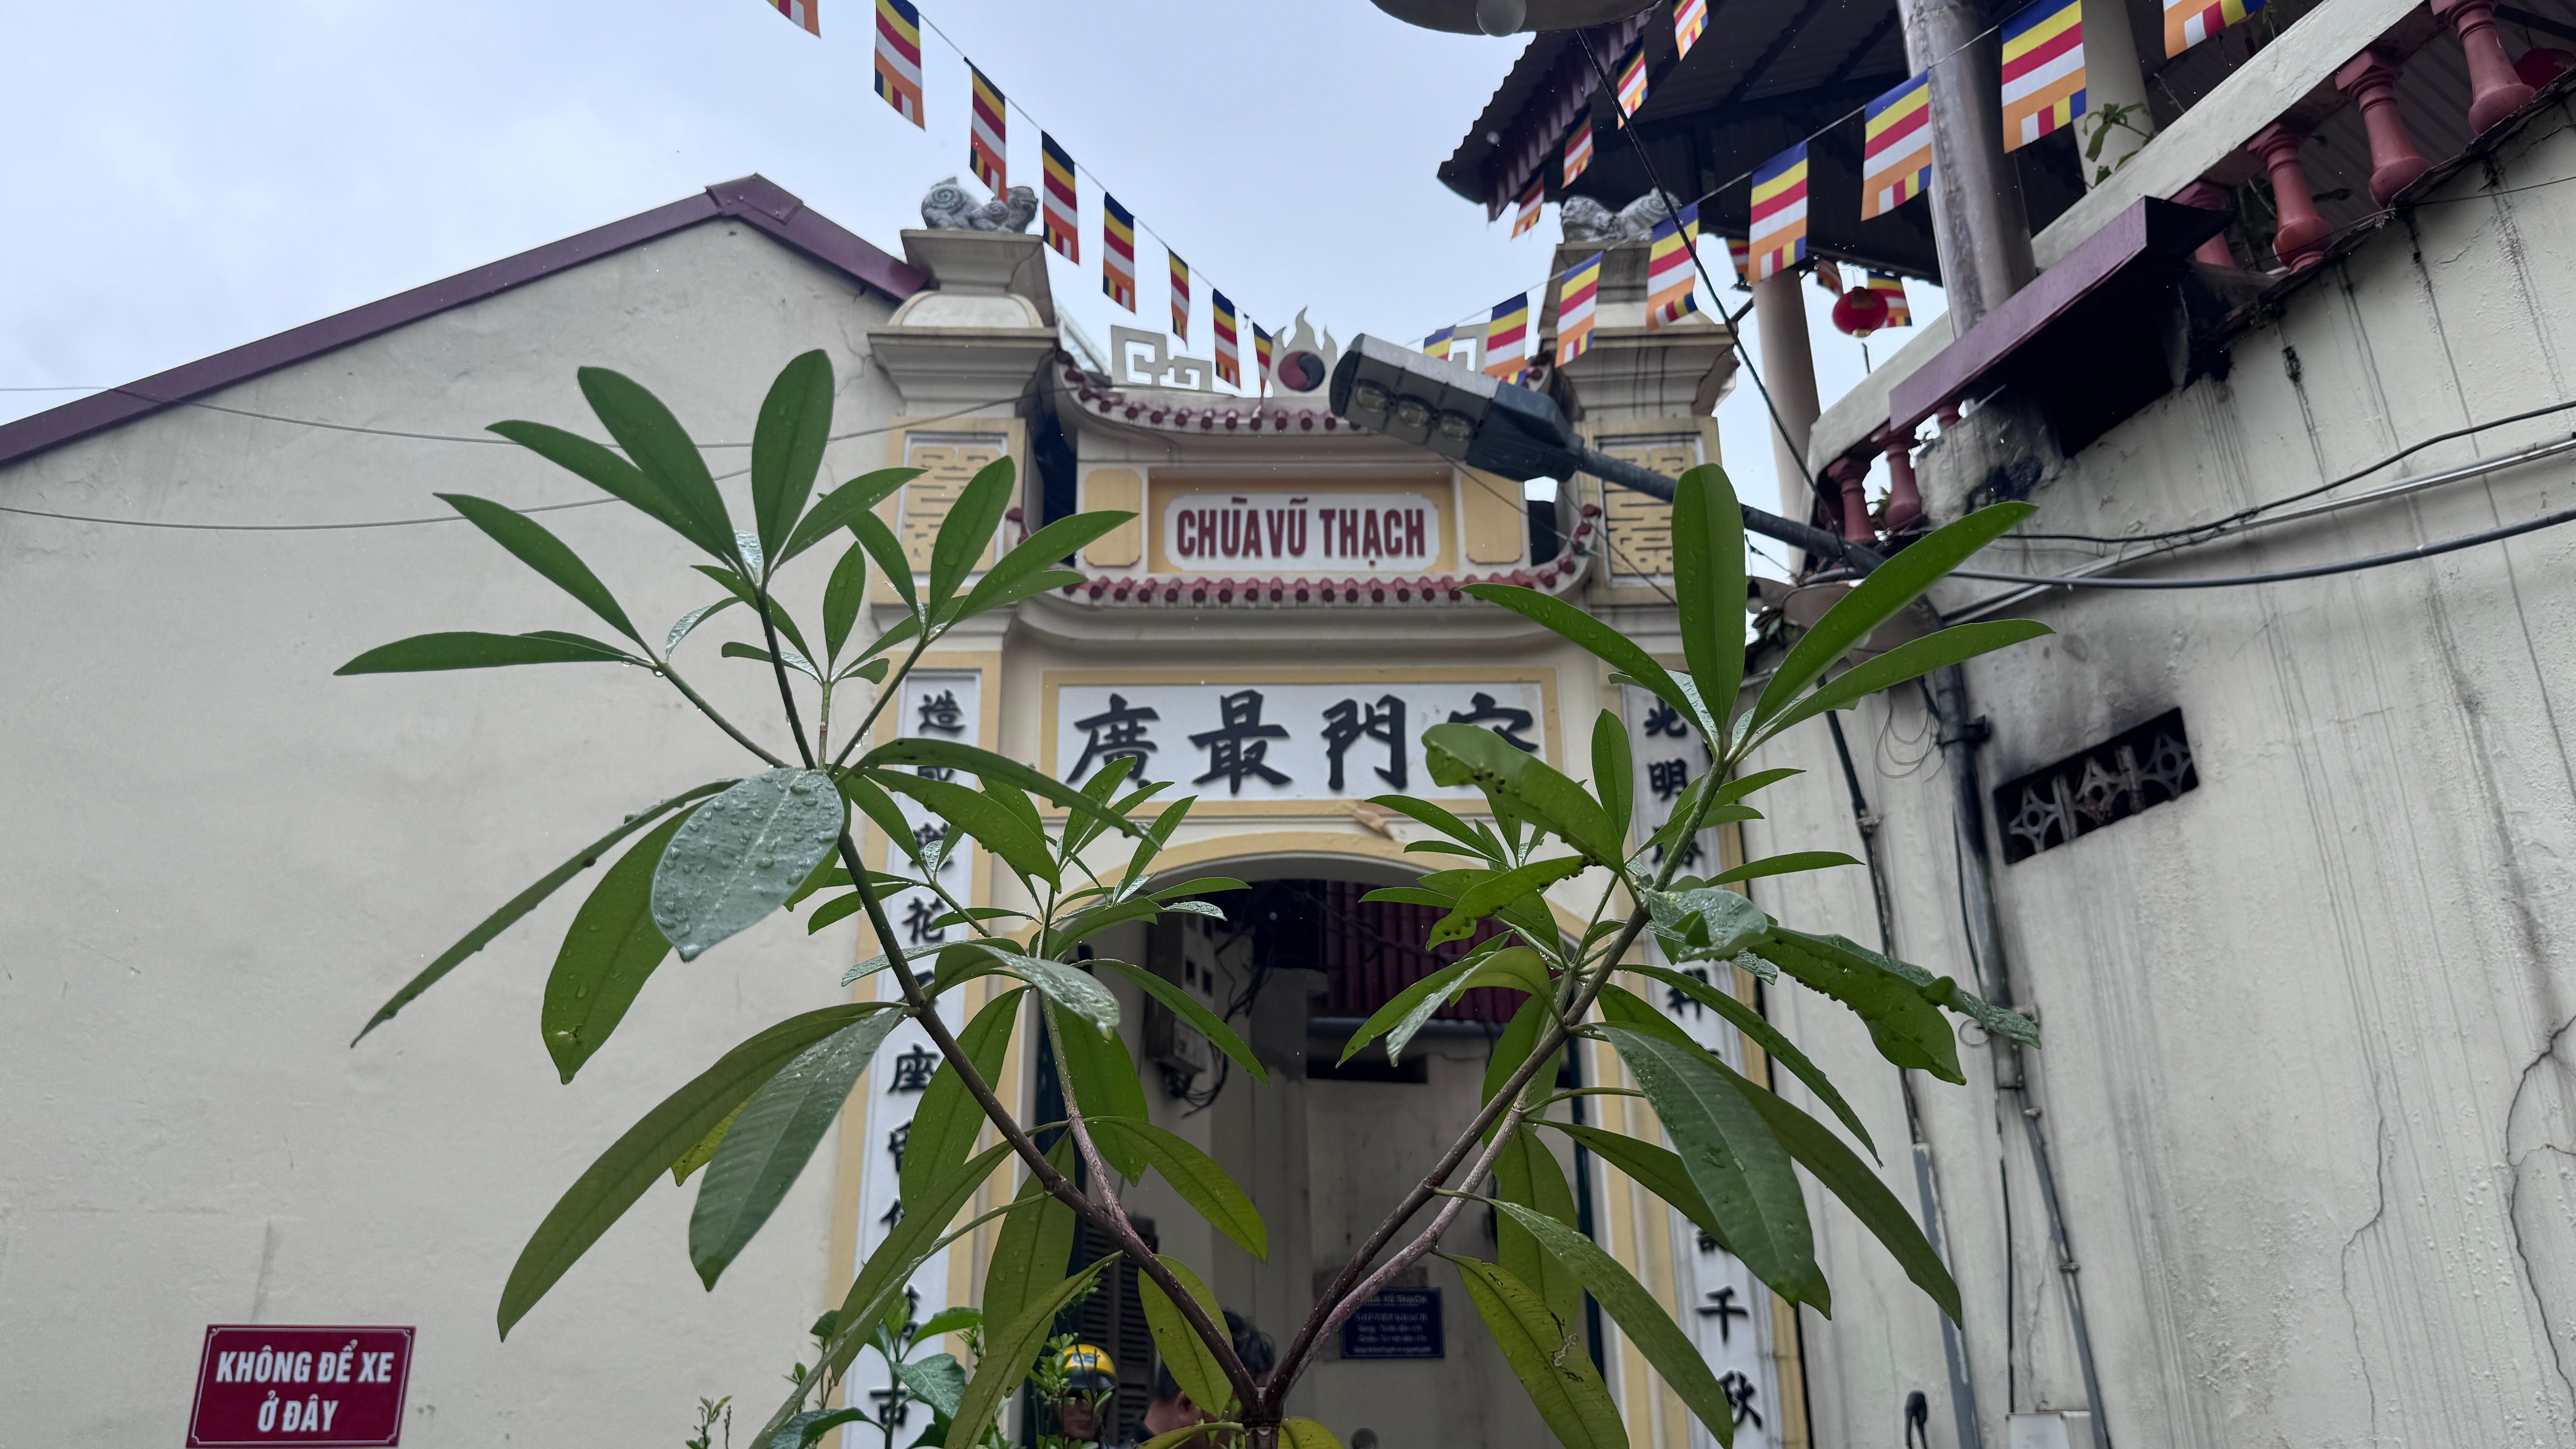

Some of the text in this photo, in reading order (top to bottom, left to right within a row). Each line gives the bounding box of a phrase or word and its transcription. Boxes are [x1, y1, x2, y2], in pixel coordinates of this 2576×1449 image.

[1319, 509, 1425, 567] THẠCH
[216, 1339, 395, 1383] KHÔNG ĐỂ XE
[258, 1389, 339, 1432] Ở ĐÂY
